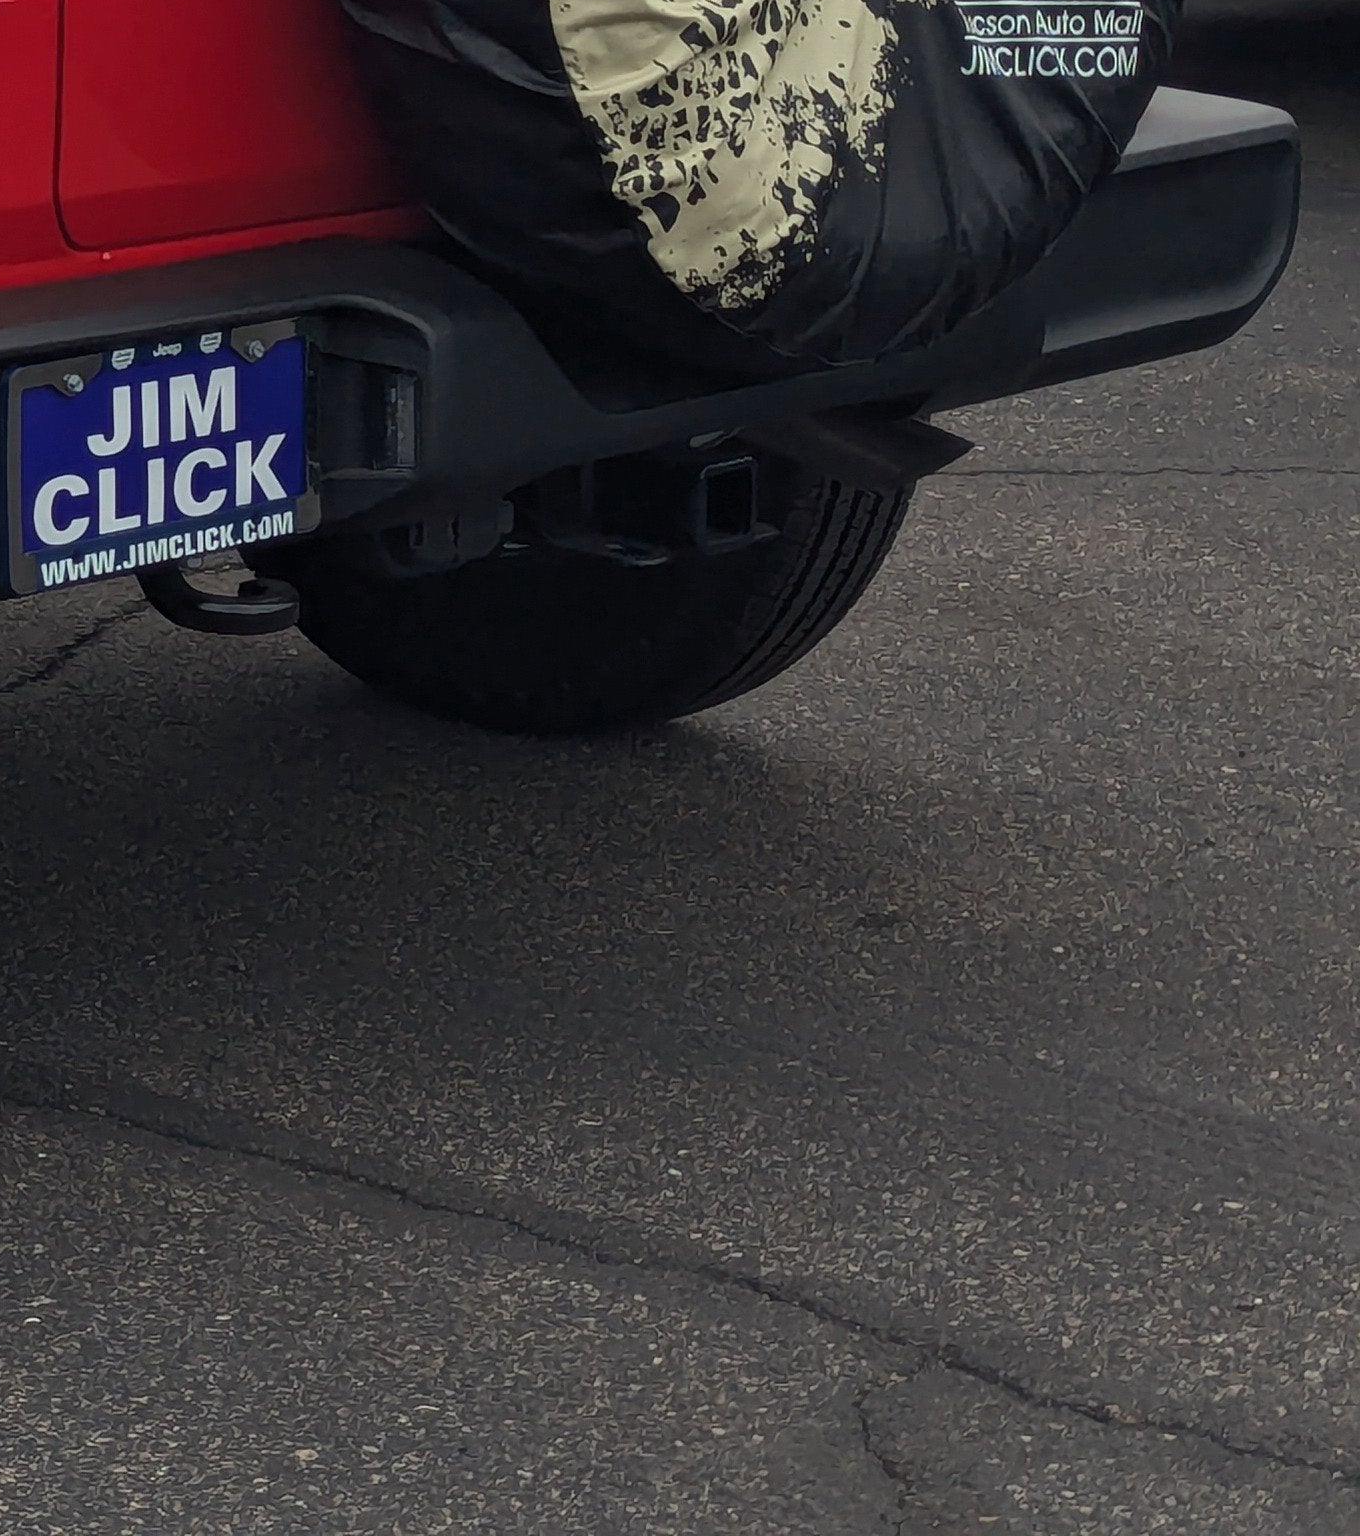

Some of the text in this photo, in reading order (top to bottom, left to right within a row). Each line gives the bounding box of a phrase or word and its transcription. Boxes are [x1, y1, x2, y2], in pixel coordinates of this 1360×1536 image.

[959, 8, 1030, 36] cson
[1036, 9, 1086, 36] Auto
[86, 365, 237, 457] JIM
[33, 432, 288, 546] CLICK
